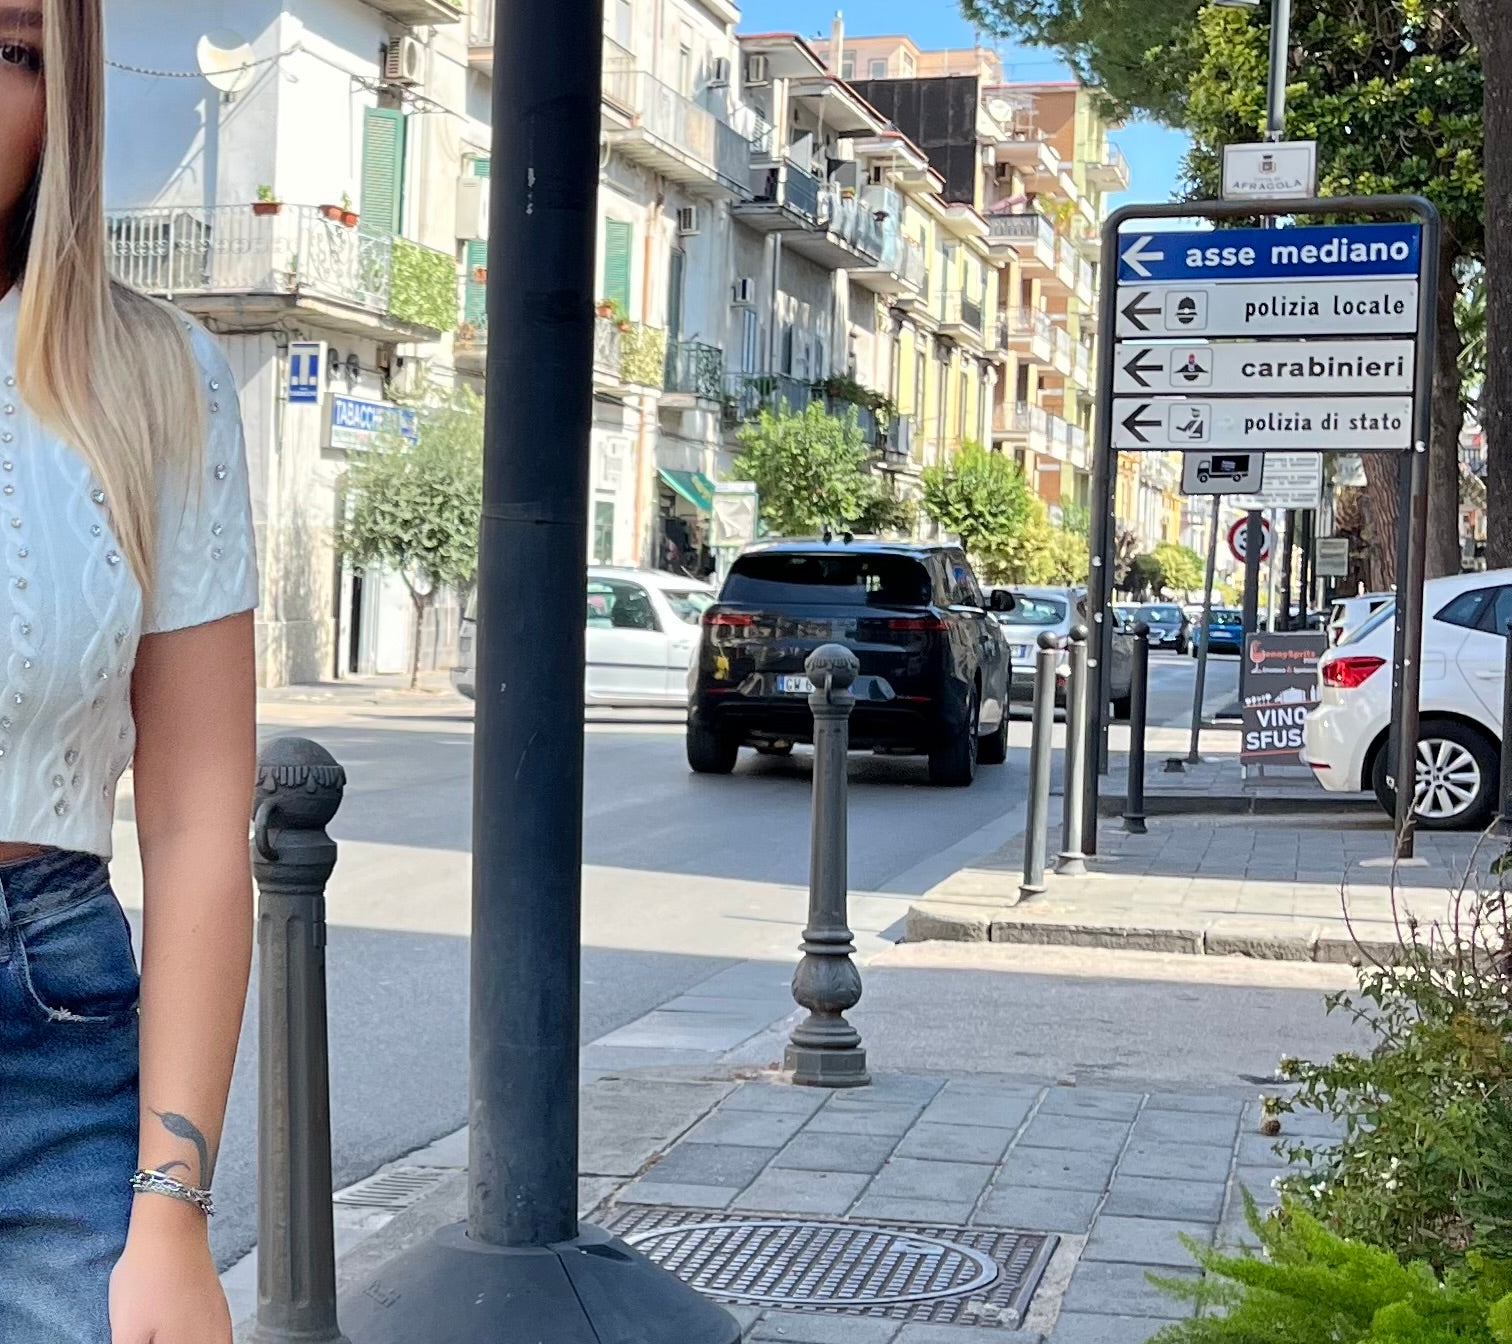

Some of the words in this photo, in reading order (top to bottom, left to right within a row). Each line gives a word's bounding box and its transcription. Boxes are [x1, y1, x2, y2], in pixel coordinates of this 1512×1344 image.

[1232, 179, 1302, 190] AFRAGOLA
[1185, 246, 1256, 268] asse
[1270, 237, 1410, 266] mediano
[1244, 294, 1320, 323] polizia
[1333, 294, 1405, 318] locale
[1241, 356, 1405, 379] carabinieri
[1244, 413, 1313, 434] polizia
[1320, 411, 1340, 432] di
[1348, 413, 1402, 432] stato
[1256, 706, 1308, 728] VINO
[1246, 728, 1306, 750] SFUS
